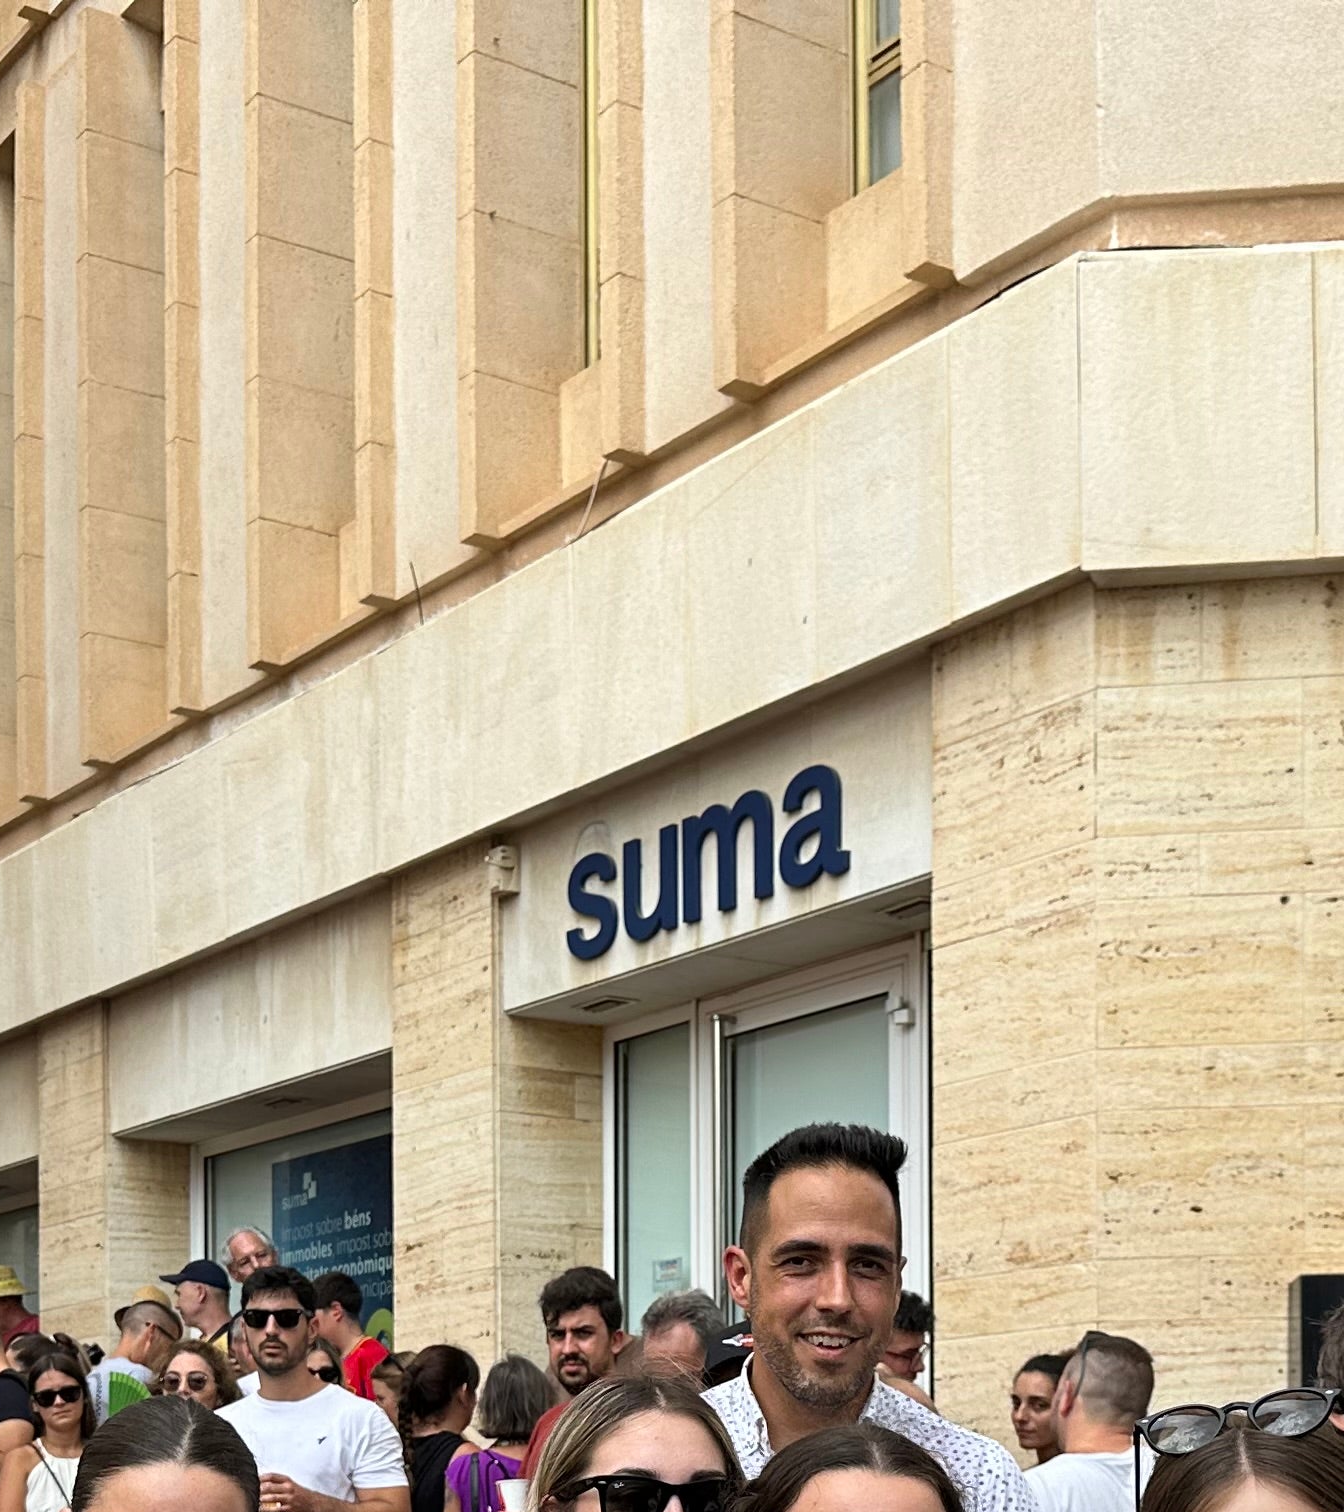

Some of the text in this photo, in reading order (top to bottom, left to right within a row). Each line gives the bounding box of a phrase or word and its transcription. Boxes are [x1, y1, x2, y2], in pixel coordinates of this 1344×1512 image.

[566, 764, 852, 961] suma
[315, 1216, 342, 1236] sobre
[344, 1209, 372, 1230] béns
[372, 1228, 393, 1247] sob
